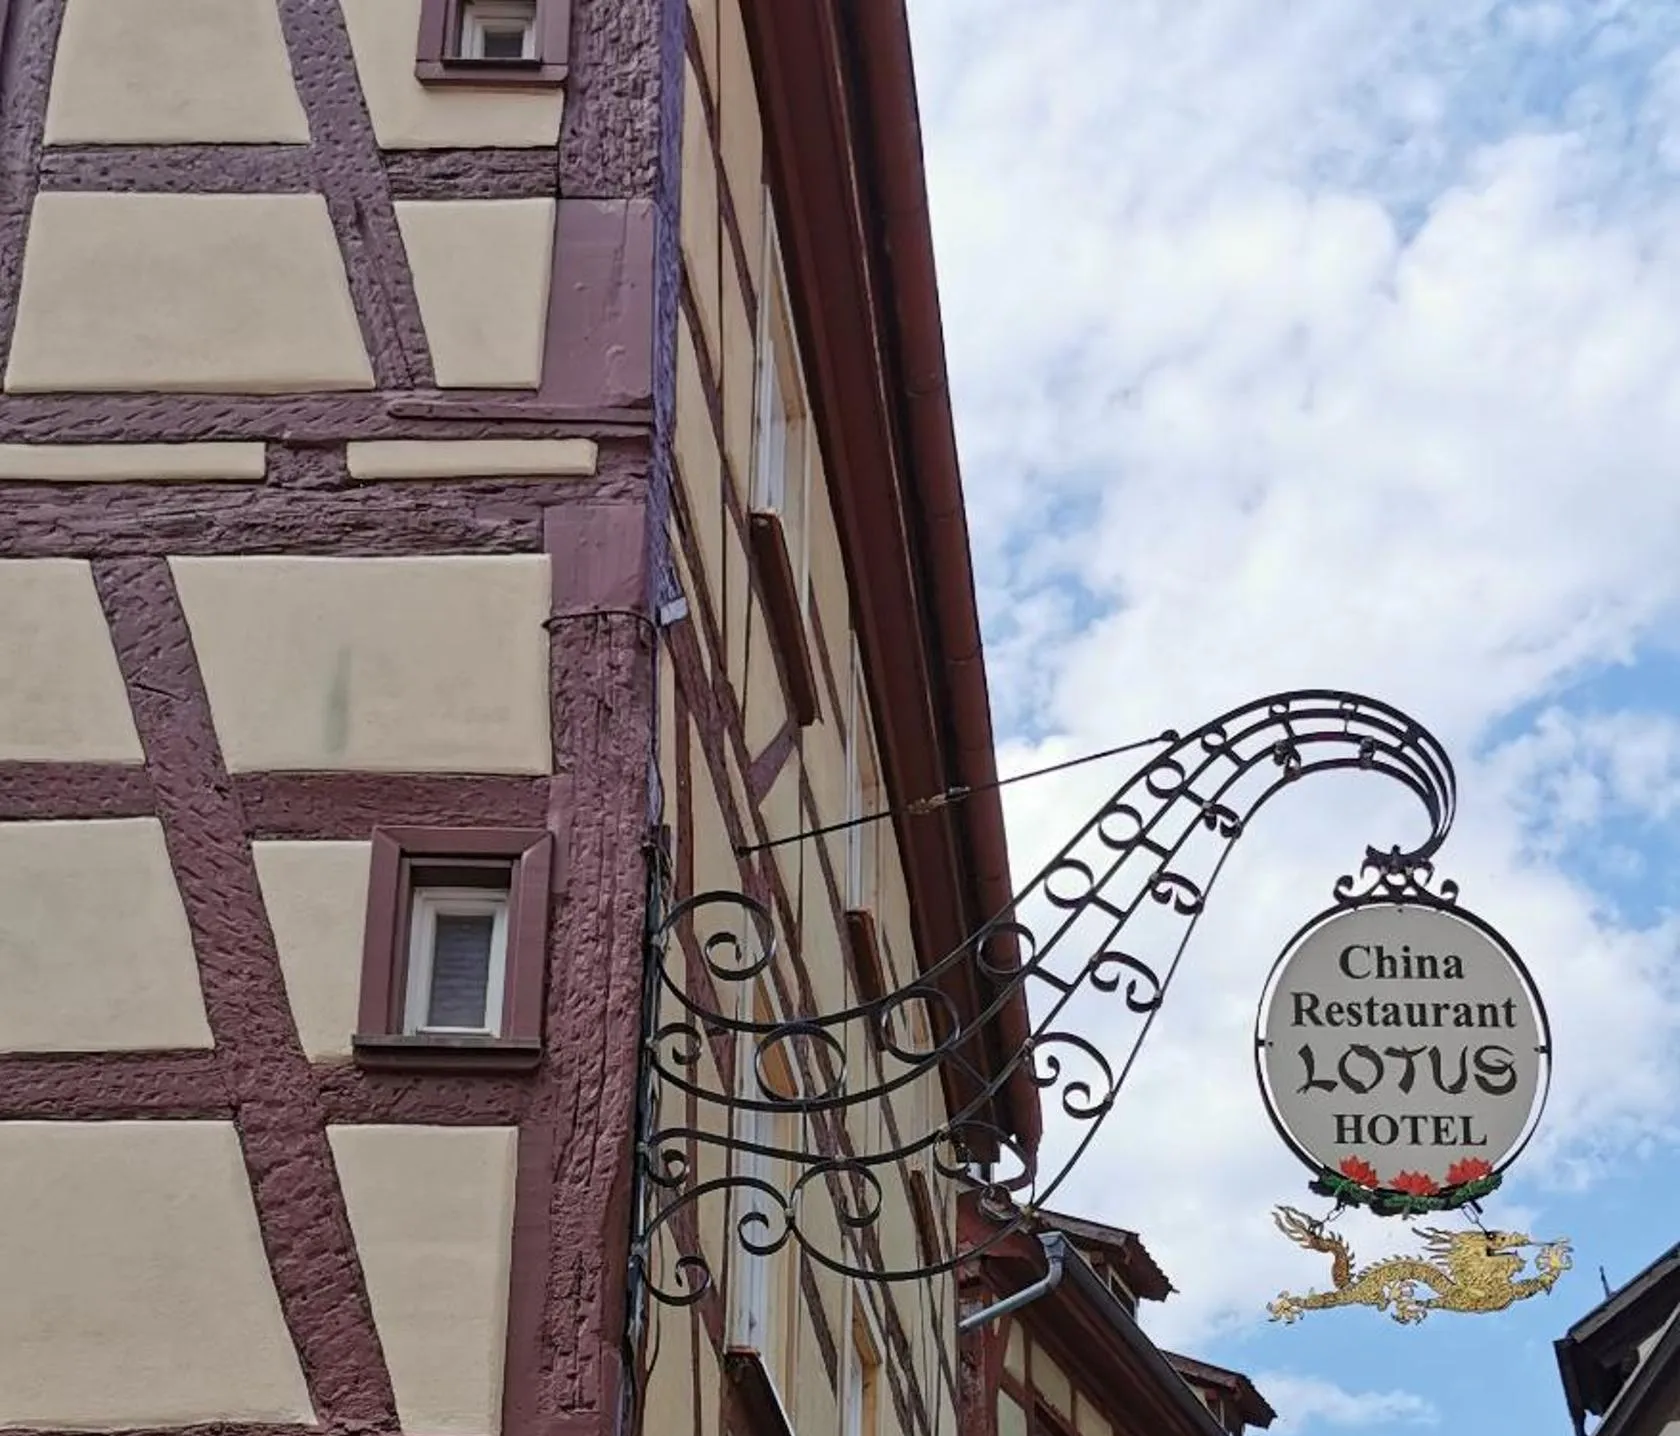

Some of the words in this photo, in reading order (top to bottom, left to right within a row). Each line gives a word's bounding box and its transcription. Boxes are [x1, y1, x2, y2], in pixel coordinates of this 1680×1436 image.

[1339, 945, 1464, 980] China
[1290, 992, 1517, 1028] Restaurant
[1296, 1044, 1518, 1096] LOTUS
[1333, 1114, 1488, 1146] HOTEL
